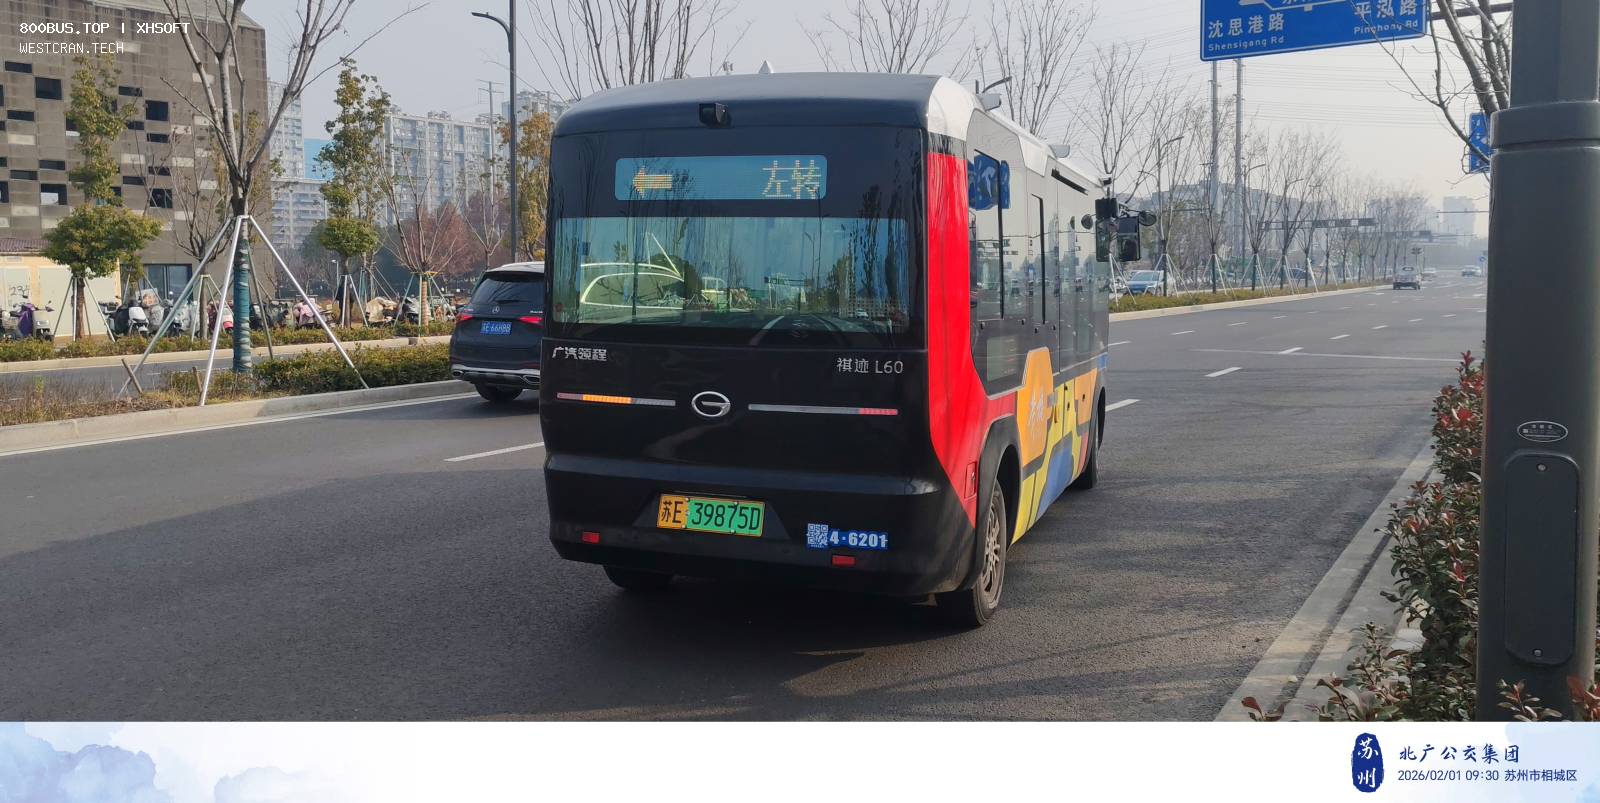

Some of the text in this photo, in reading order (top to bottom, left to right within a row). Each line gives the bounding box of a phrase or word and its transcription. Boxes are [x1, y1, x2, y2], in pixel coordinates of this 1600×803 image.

[1208, 12, 1285, 39] 沈思港路
[1406, 19, 1418, 29] Rd
[1208, 36, 1285, 51] Shensigang Rd
[762, 160, 821, 200] 左转
[551, 346, 608, 362] 广汽领程
[837, 357, 904, 374] 祺迹 L60
